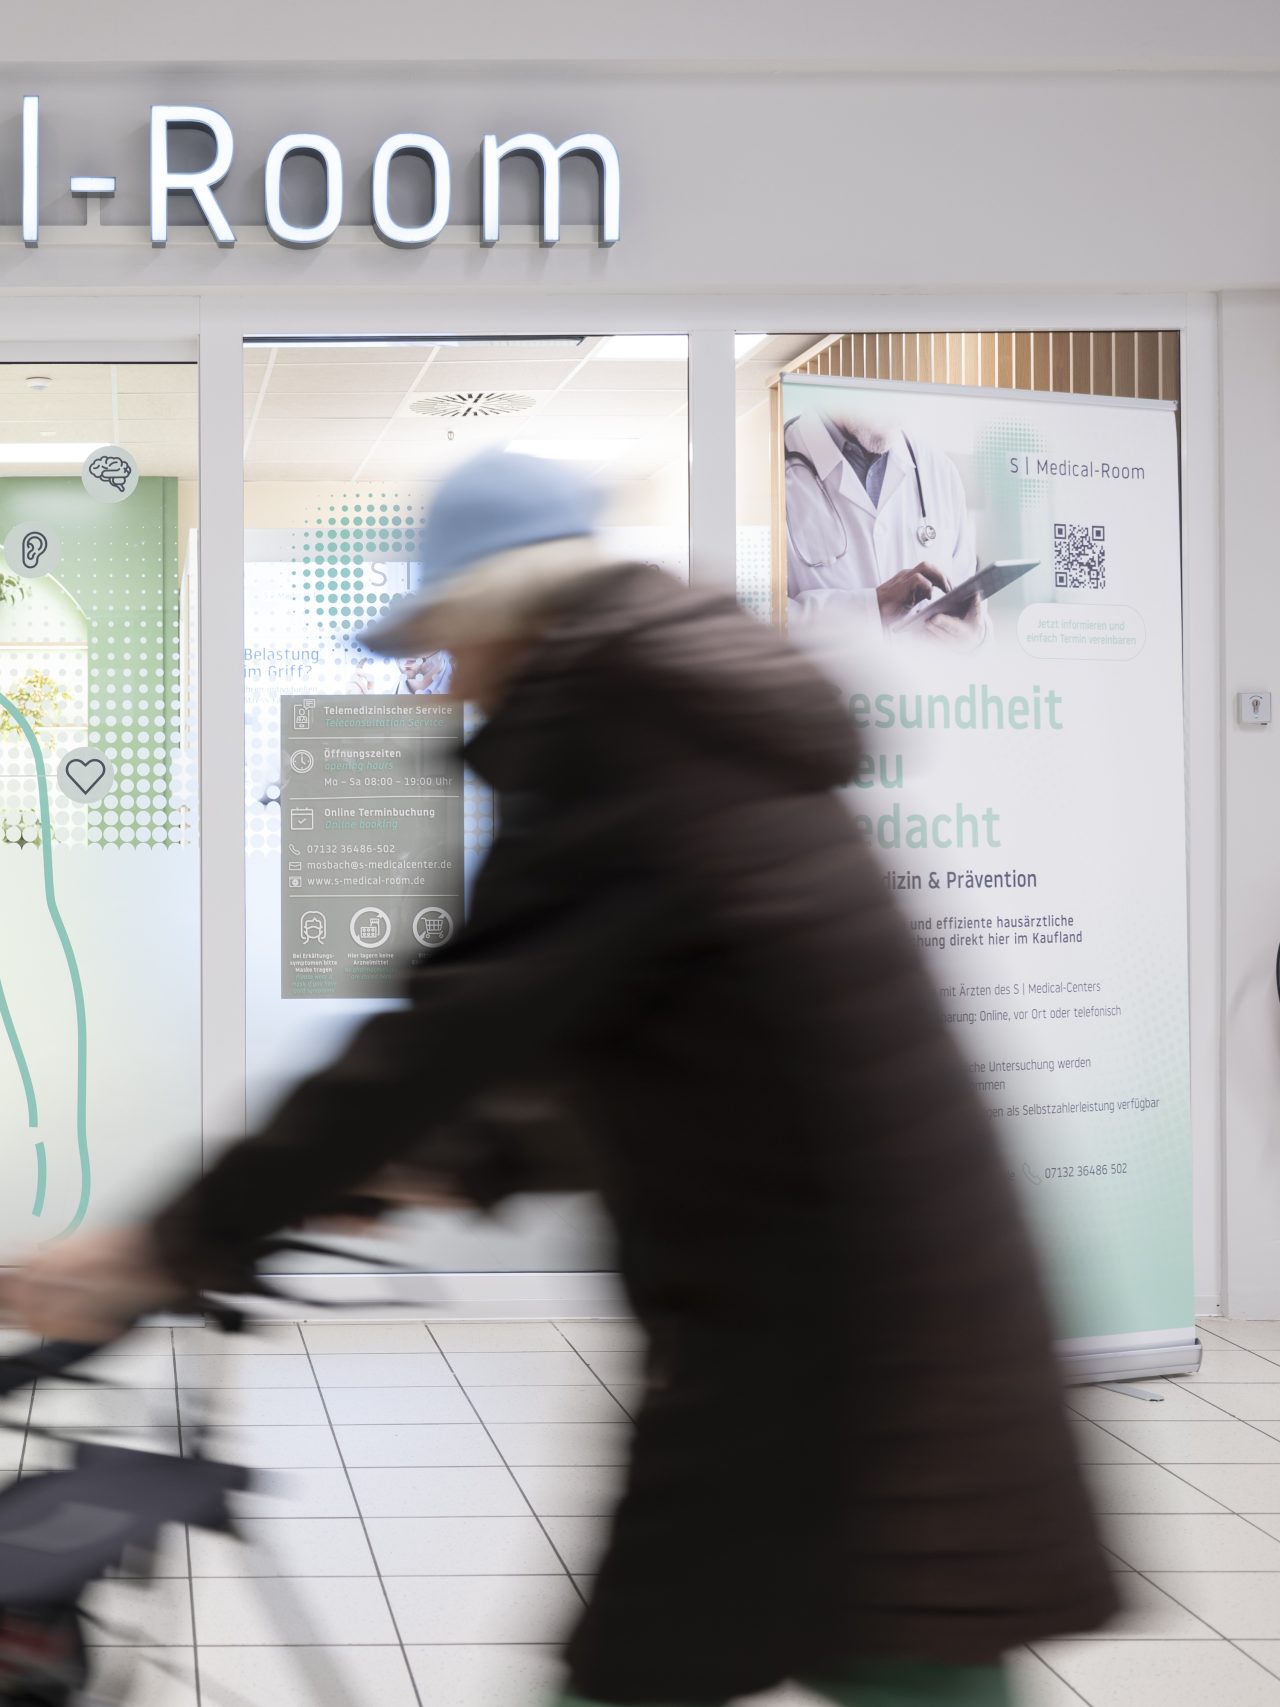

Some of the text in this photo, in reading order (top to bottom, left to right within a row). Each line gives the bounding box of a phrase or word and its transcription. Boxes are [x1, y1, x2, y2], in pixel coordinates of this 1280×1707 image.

[1010, 457, 1019, 474] S
[1036, 457, 1146, 481] Medical-Room
[1038, 617, 1125, 632] Jetzt informieren und
[1026, 631, 1137, 647] einfach Termin vereinbaren
[243, 647, 320, 664] Belastung
[268, 665, 313, 678] Griff?
[323, 705, 454, 716] Telemedizinischer Service
[848, 683, 1065, 731] esundheit
[408, 717, 445, 729] Service
[323, 747, 402, 760] Öffnungszeiten
[839, 754, 904, 789] eu
[324, 777, 338, 787] Mo
[349, 777, 361, 787] Sa
[364, 776, 393, 787] 08:00
[404, 776, 433, 787] 19:00
[435, 776, 453, 786] Uhr
[324, 807, 436, 819] Online Terminbuchung
[854, 802, 1002, 849] edacht
[306, 844, 396, 854] 07132 36486-502
[306, 859, 453, 871] mosbach@s-medicalcenter.de
[306, 875, 426, 886] www.s-medical-room.de
[881, 869, 1038, 891] dizin & Prävention
[910, 914, 1075, 931] und effiziente hausärztliche
[914, 929, 1083, 950] hung direkt hier im Kaufland
[939, 986, 957, 998] mit
[959, 983, 992, 997] Ärzten
[994, 983, 1011, 996] des
[1013, 983, 1020, 995] S
[1028, 981, 1102, 995] Medical-Centers
[979, 1009, 1012, 1023] Online,
[1013, 1010, 1028, 1020] vor
[1031, 1008, 1047, 1020] Ort
[1049, 1007, 1071, 1020] oder
[1073, 1004, 1122, 1018] telefonisch
[989, 1058, 1055, 1073] Untersuchung
[1057, 1056, 1092, 1069] werden
[1006, 1104, 1020, 1117] als
[1022, 1099, 1116, 1117] Selbstzahlerleistung
[1116, 1096, 1161, 1113] verfügbar
[1044, 1162, 1128, 1180] 07132 36486 502
